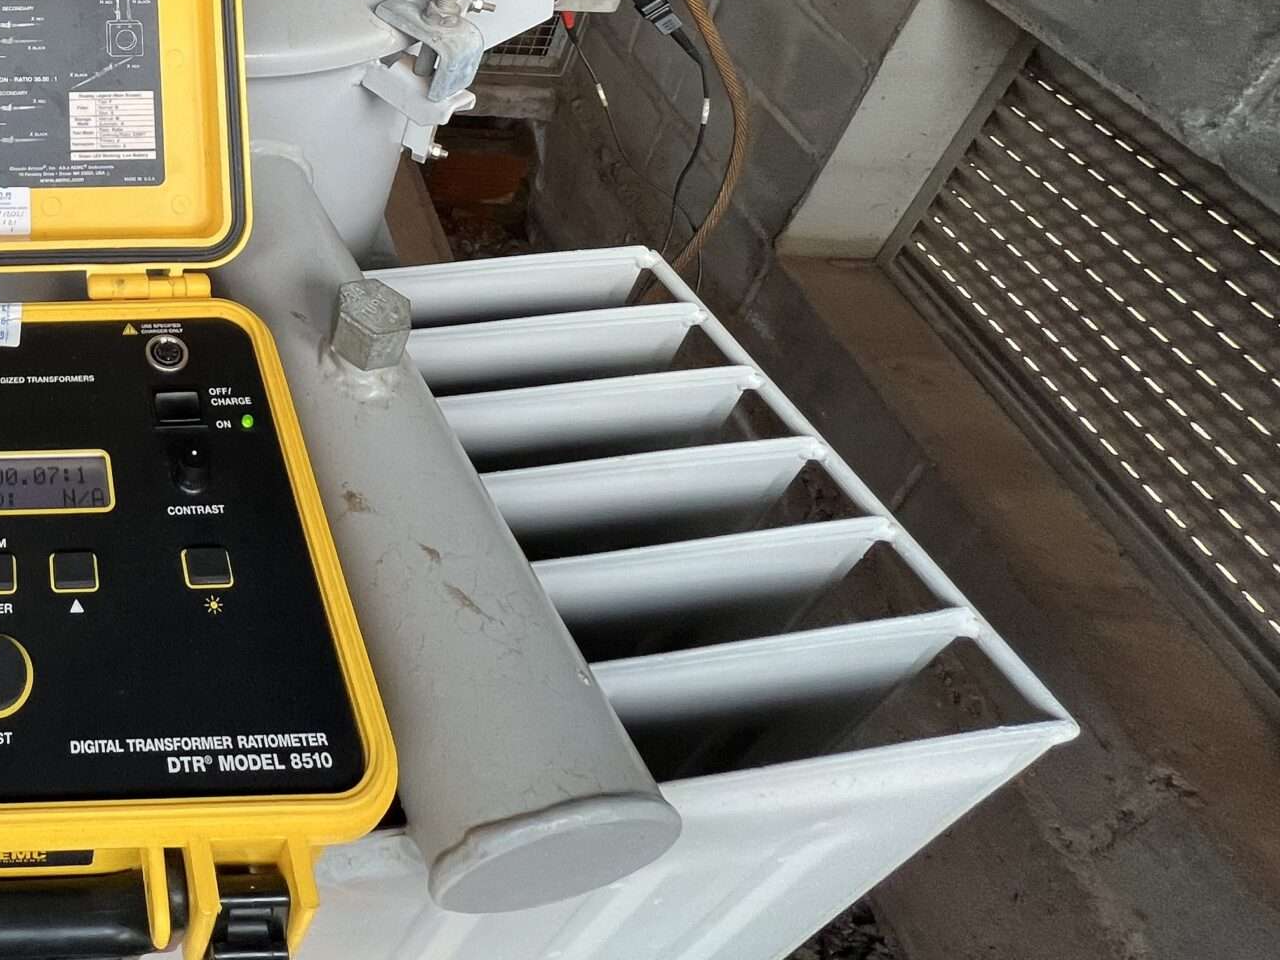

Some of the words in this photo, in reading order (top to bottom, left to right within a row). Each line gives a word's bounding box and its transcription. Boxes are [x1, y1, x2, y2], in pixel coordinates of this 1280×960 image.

[27, 374, 95, 384] TRANSFORMERS
[208, 387, 232, 396] OFF/
[210, 396, 252, 406] CHARGE
[215, 420, 232, 429] ON
[63, 488, 106, 507] N/A
[167, 504, 225, 516] CONTRAST
[70, 739, 124, 754] DIGITAL
[126, 736, 233, 752] TRANSFORMER
[237, 732, 329, 750] RATIOMETER
[167, 754, 213, 774] DTR®
[218, 753, 285, 772] MODEL
[290, 751, 333, 769] 8510
